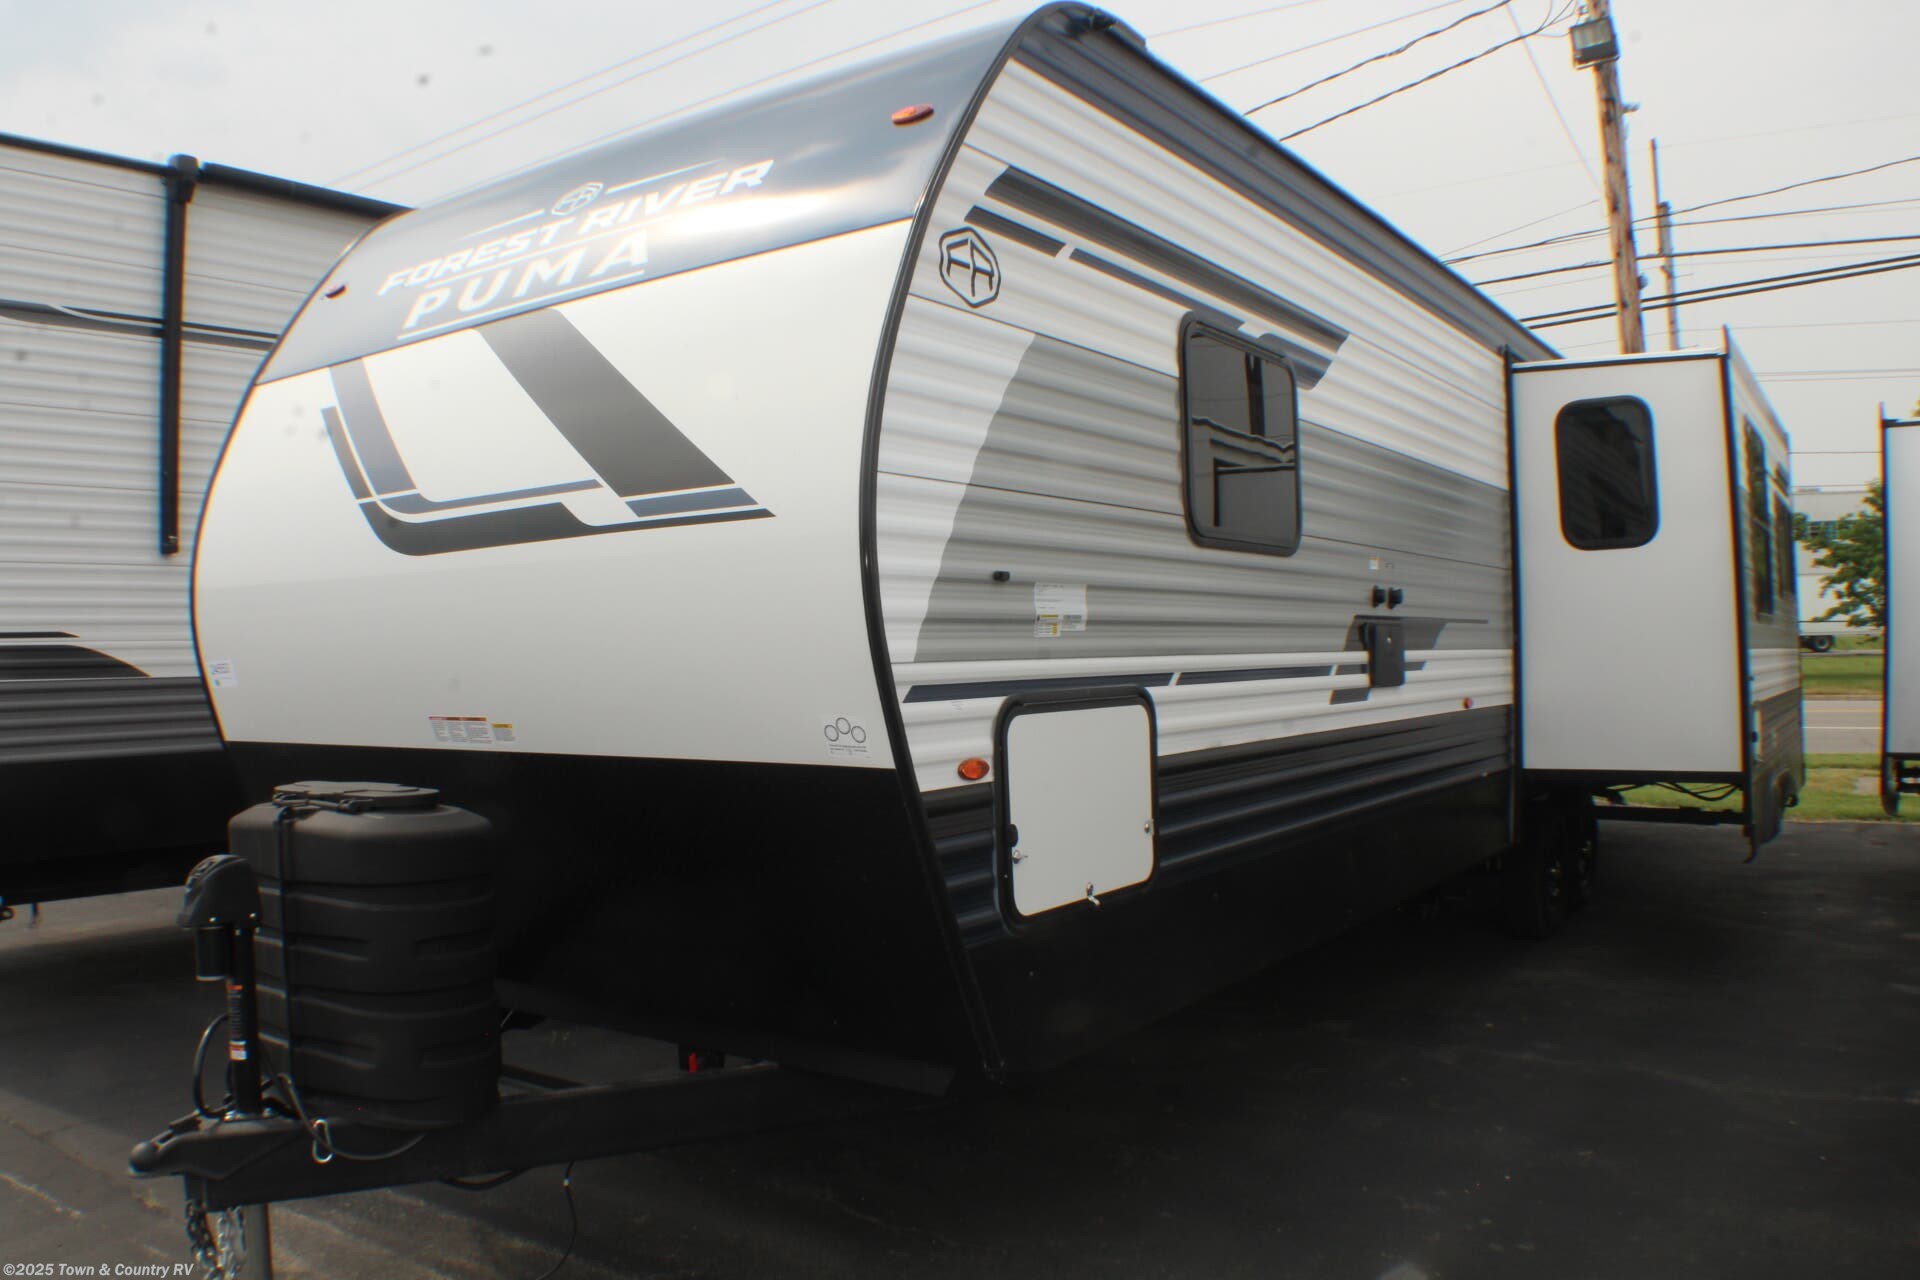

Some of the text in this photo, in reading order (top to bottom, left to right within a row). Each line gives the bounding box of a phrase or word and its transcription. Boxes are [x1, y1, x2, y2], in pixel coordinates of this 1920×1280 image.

[376, 159, 774, 296] FOREST RIVER
[403, 230, 648, 329] PUMA
